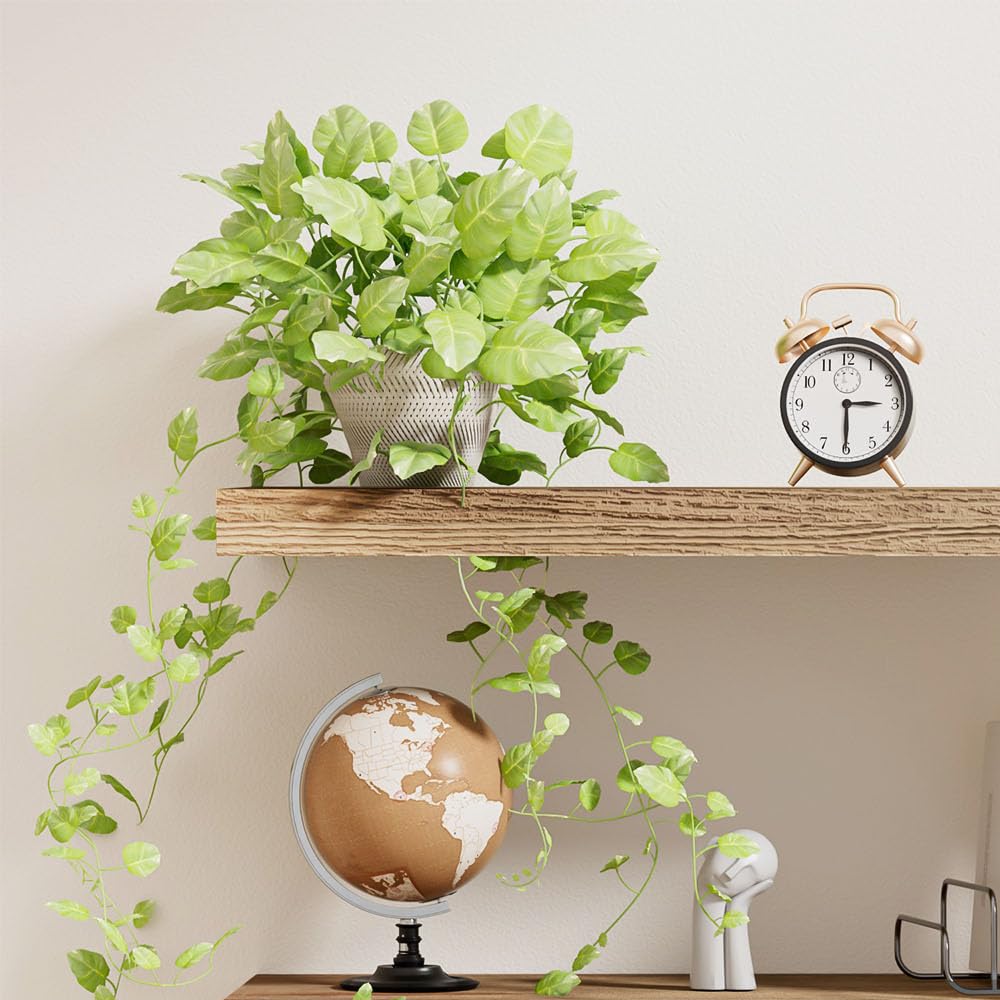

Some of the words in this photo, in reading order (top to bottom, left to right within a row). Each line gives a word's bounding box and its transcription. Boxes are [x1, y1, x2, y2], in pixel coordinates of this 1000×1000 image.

[822, 359, 832, 372] 11
[842, 353, 855, 366] 12
[868, 358, 873, 371] 1
[804, 375, 816, 388] 10
[884, 374, 893, 387] 2
[795, 398, 804, 411] 9
[891, 397, 900, 410] 3
[801, 420, 810, 433] 8
[882, 420, 892, 432] 4
[819, 436, 828, 449] 7
[842, 442, 851, 455] 6
[868, 436, 877, 449] 5
